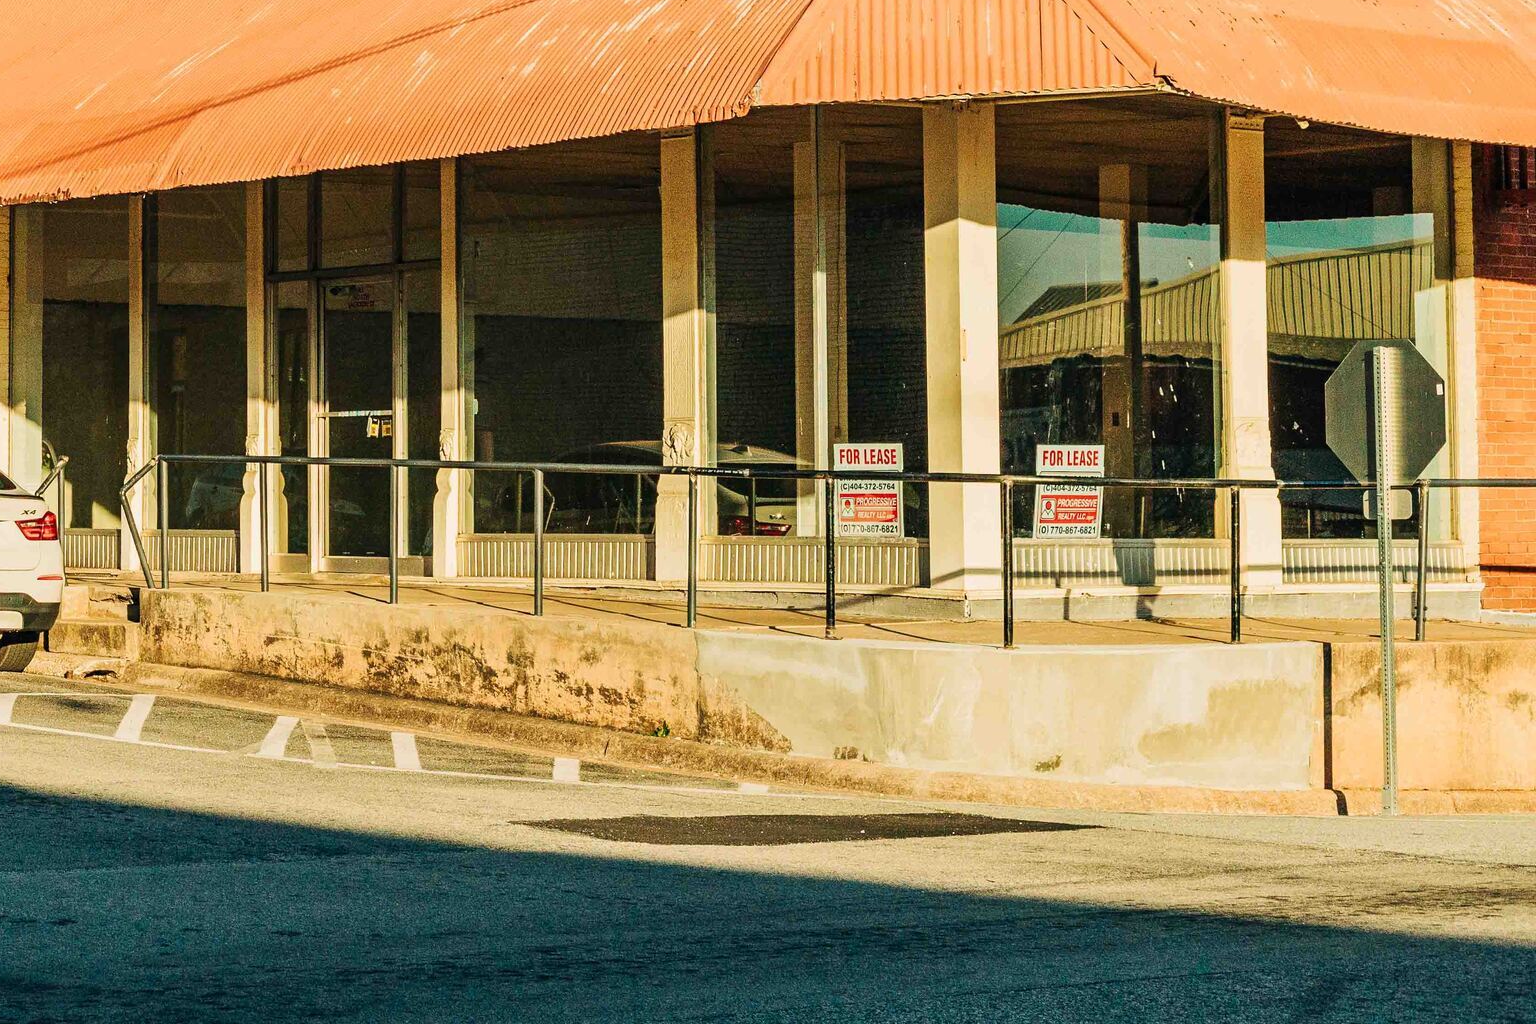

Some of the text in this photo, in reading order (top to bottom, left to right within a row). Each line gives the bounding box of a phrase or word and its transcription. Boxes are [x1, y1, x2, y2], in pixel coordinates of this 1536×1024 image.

[839, 449, 897, 465] FOR LEASE
[1042, 450, 1098, 466] FOR LEASE
[855, 497, 897, 506] PROGRESSIVE
[1057, 498, 1097, 507] PROGRESSIVE
[857, 511, 887, 519] REALTY LLC
[1058, 512, 1086, 520] REALTY LLC
